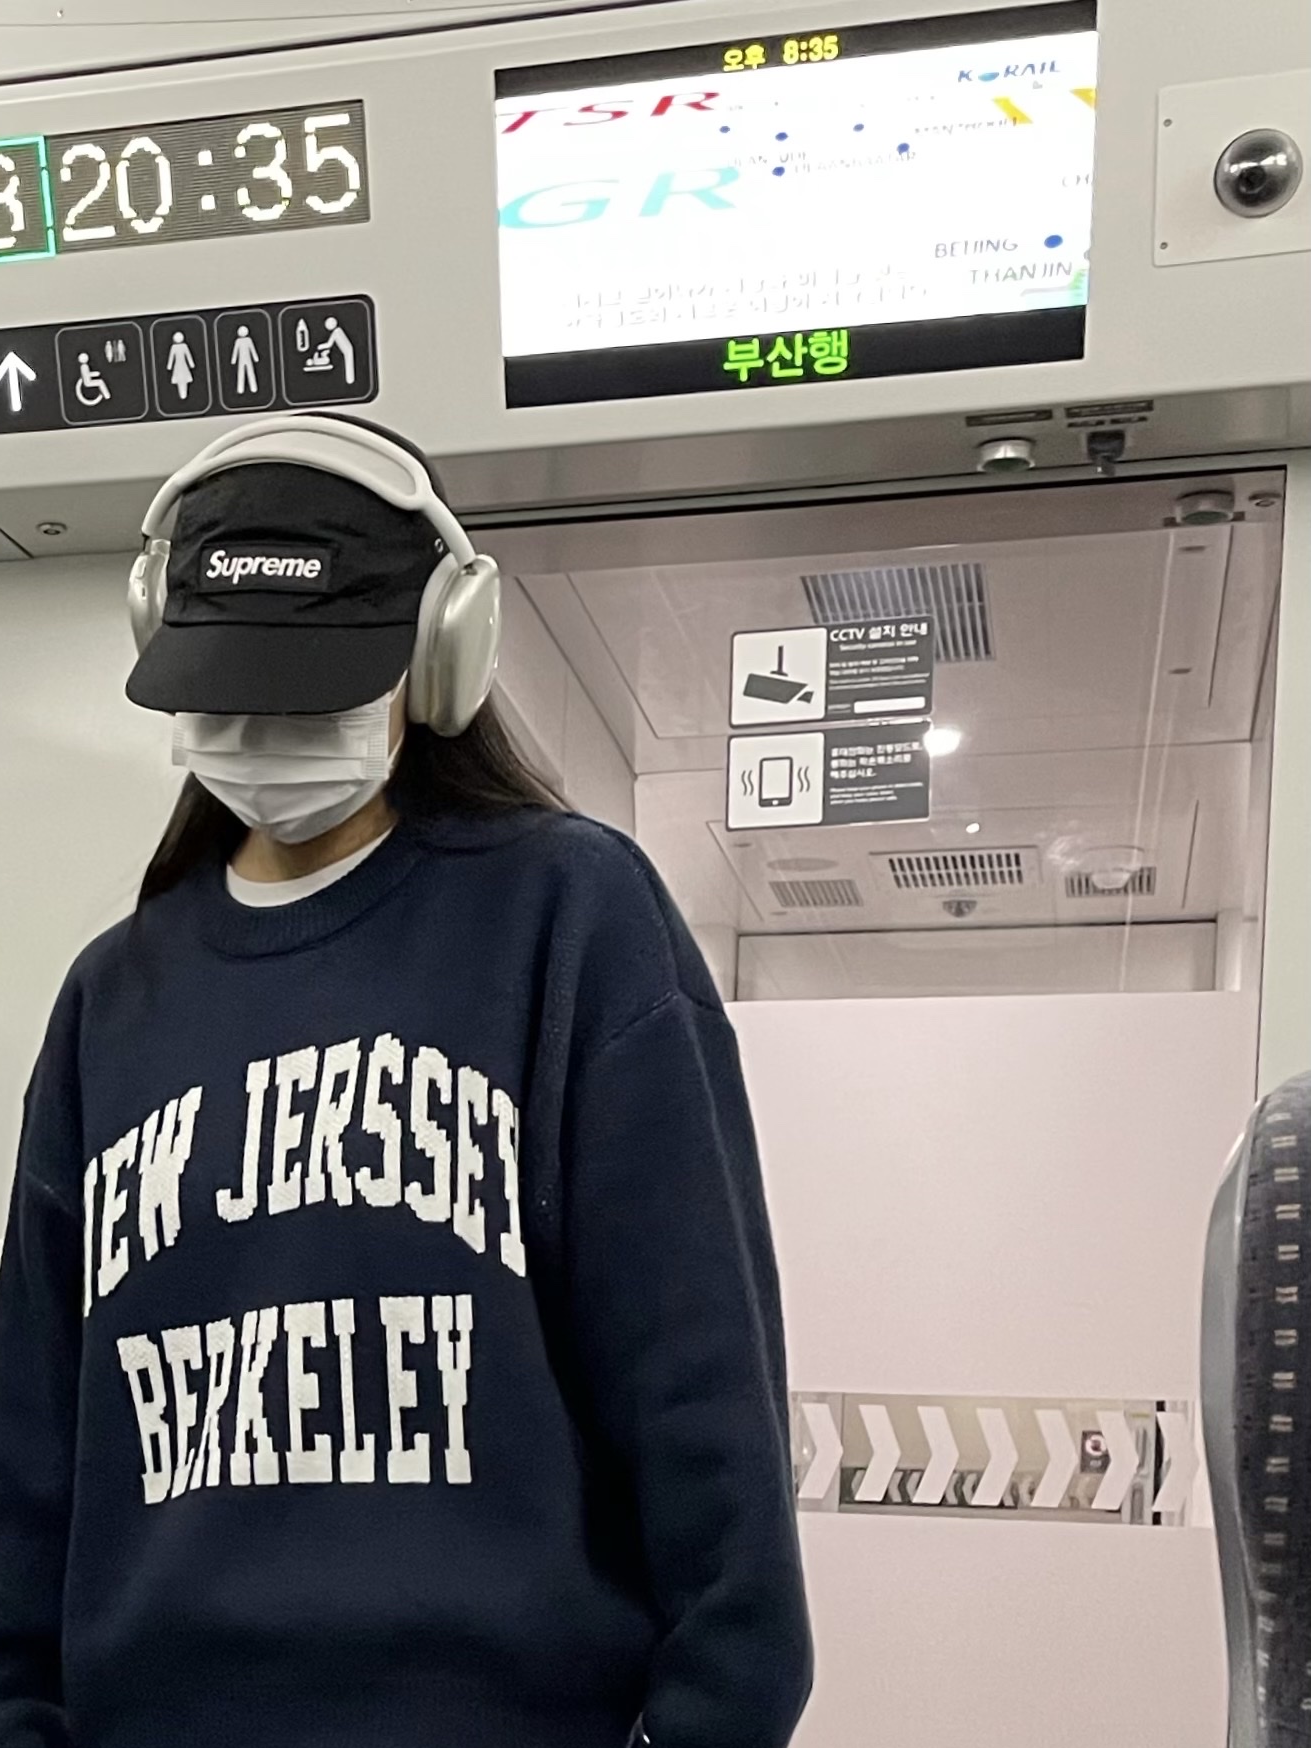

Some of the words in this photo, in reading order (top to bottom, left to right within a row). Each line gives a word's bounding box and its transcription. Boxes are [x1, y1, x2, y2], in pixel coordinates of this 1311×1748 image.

[722, 45, 766, 72] 오후
[783, 35, 839, 65] 8:35
[497, 91, 720, 134] TSR
[60, 113, 361, 242] 20:35
[722, 328, 850, 384] 부산행
[205, 550, 322, 584] Supreme
[830, 628, 865, 642] CCTV
[900, 622, 928, 637] 안내
[116, 1293, 474, 1506] BERKELEY
